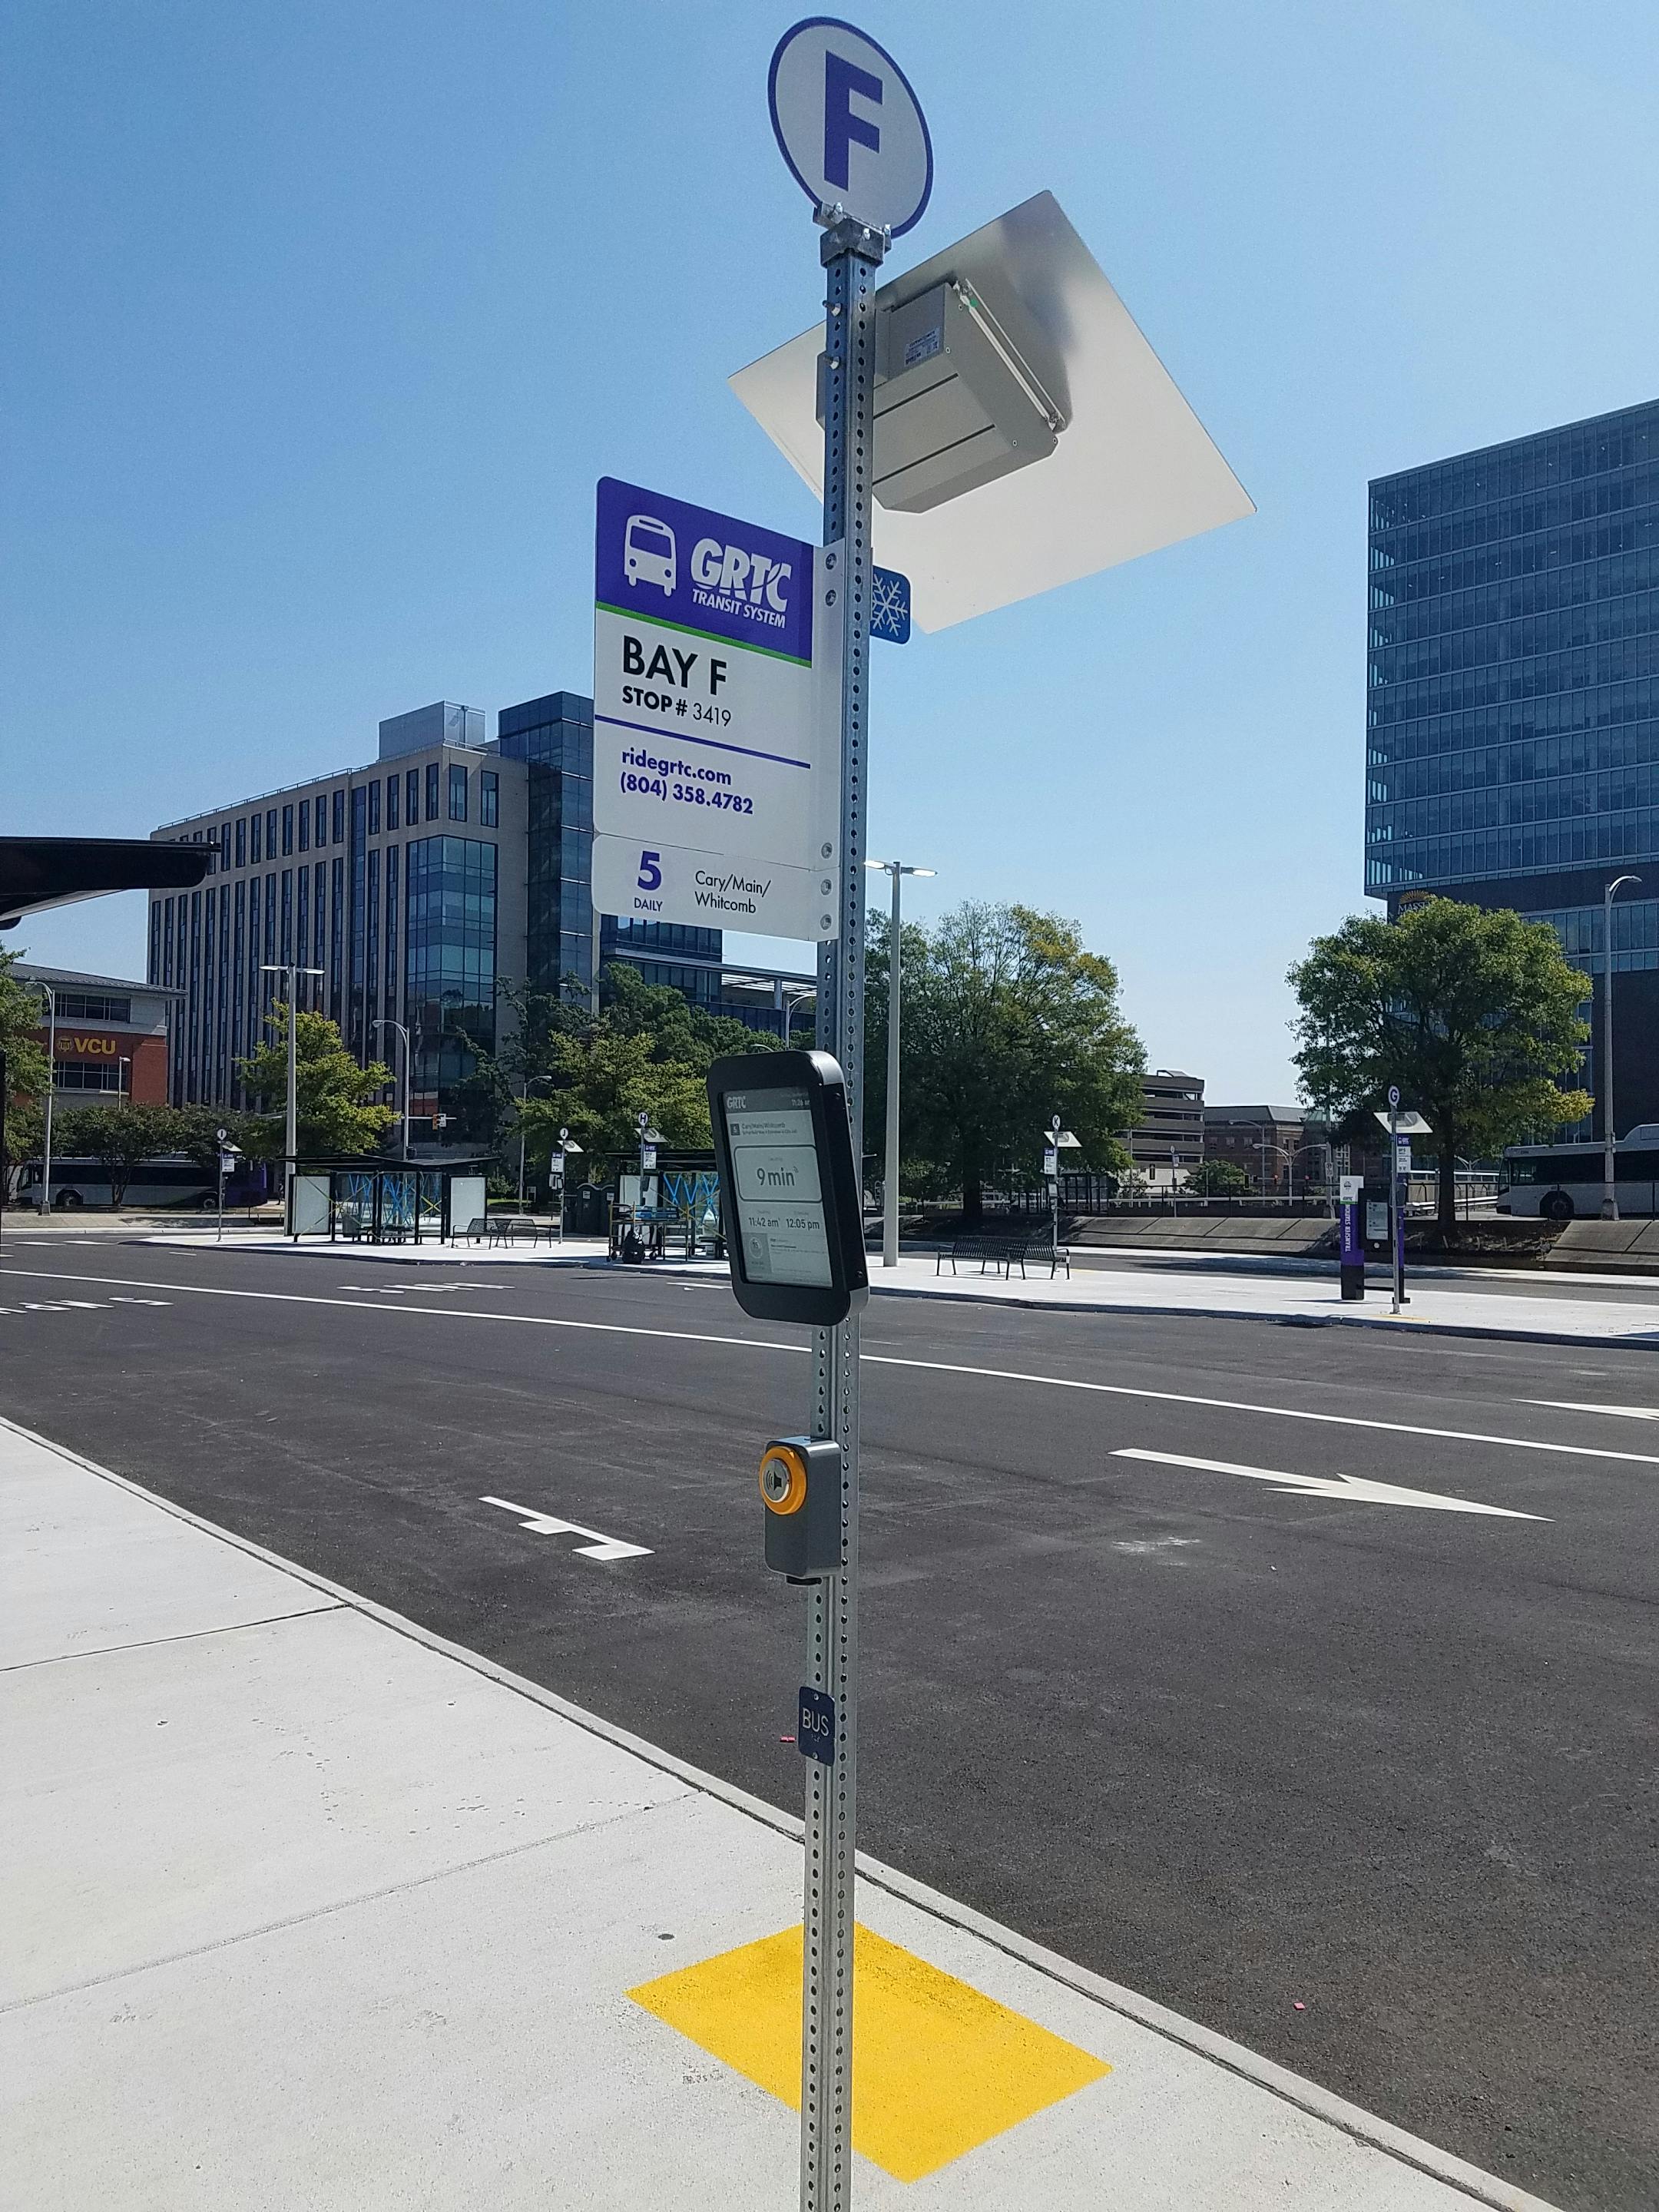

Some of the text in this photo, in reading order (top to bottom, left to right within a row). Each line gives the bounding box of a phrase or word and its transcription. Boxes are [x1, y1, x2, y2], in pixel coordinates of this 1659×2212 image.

[823, 49, 883, 192] F
[690, 538, 792, 612] GRTC
[692, 588, 786, 629] TRANSIT SYSTEM
[623, 634, 727, 696] BAY F
[692, 702, 732, 727] 3419
[621, 747, 732, 786] ridegrtc.com
[620, 771, 753, 815] (804) 358.4782
[637, 850, 662, 891] 5
[694, 869, 772, 898] Cary/Main/
[634, 896, 664, 912] DAILY
[694, 890, 757, 914] Whitcomb
[74, 1037, 116, 1055] VCU
[727, 1095, 747, 1109] GRTC
[1390, 1088, 1398, 1102] G
[640, 1114, 647, 1124] H
[1054, 1117, 1058, 1127] K
[757, 1167, 795, 1187] 9 min
[748, 1217, 779, 1227] 11:42 am
[786, 1218, 820, 1231] 12:05 pm
[802, 1707, 830, 1737] BUS
